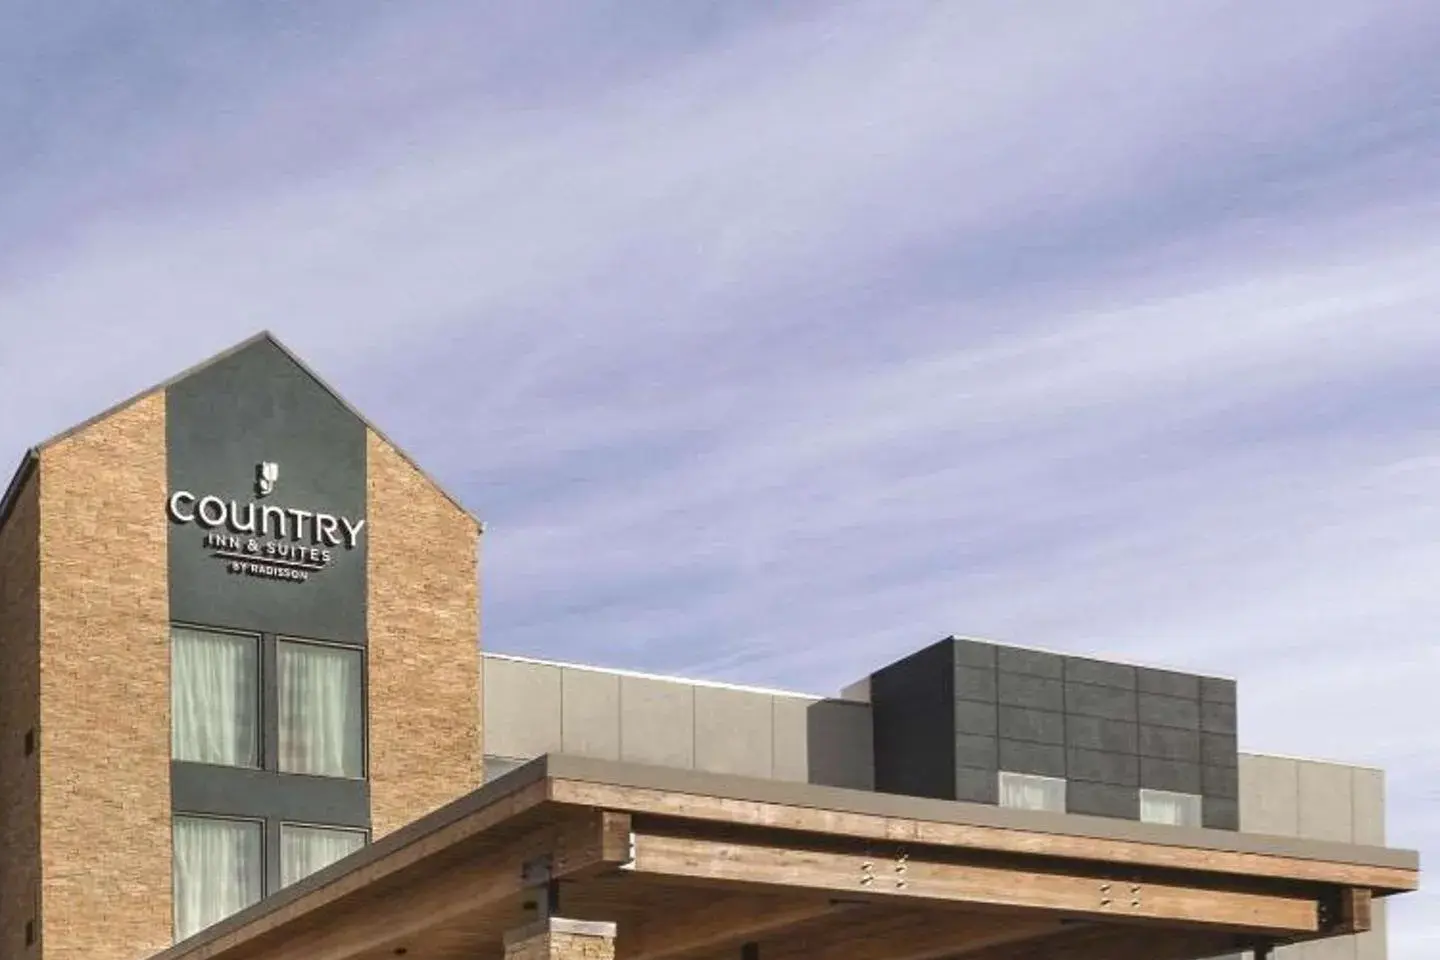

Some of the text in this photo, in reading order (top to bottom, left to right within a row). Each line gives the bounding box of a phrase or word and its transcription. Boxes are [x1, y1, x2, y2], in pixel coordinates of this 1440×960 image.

[170, 491, 364, 546] COUNTRY
[208, 533, 331, 562] INN & SUITES
[231, 561, 309, 580] BY RADISSON
